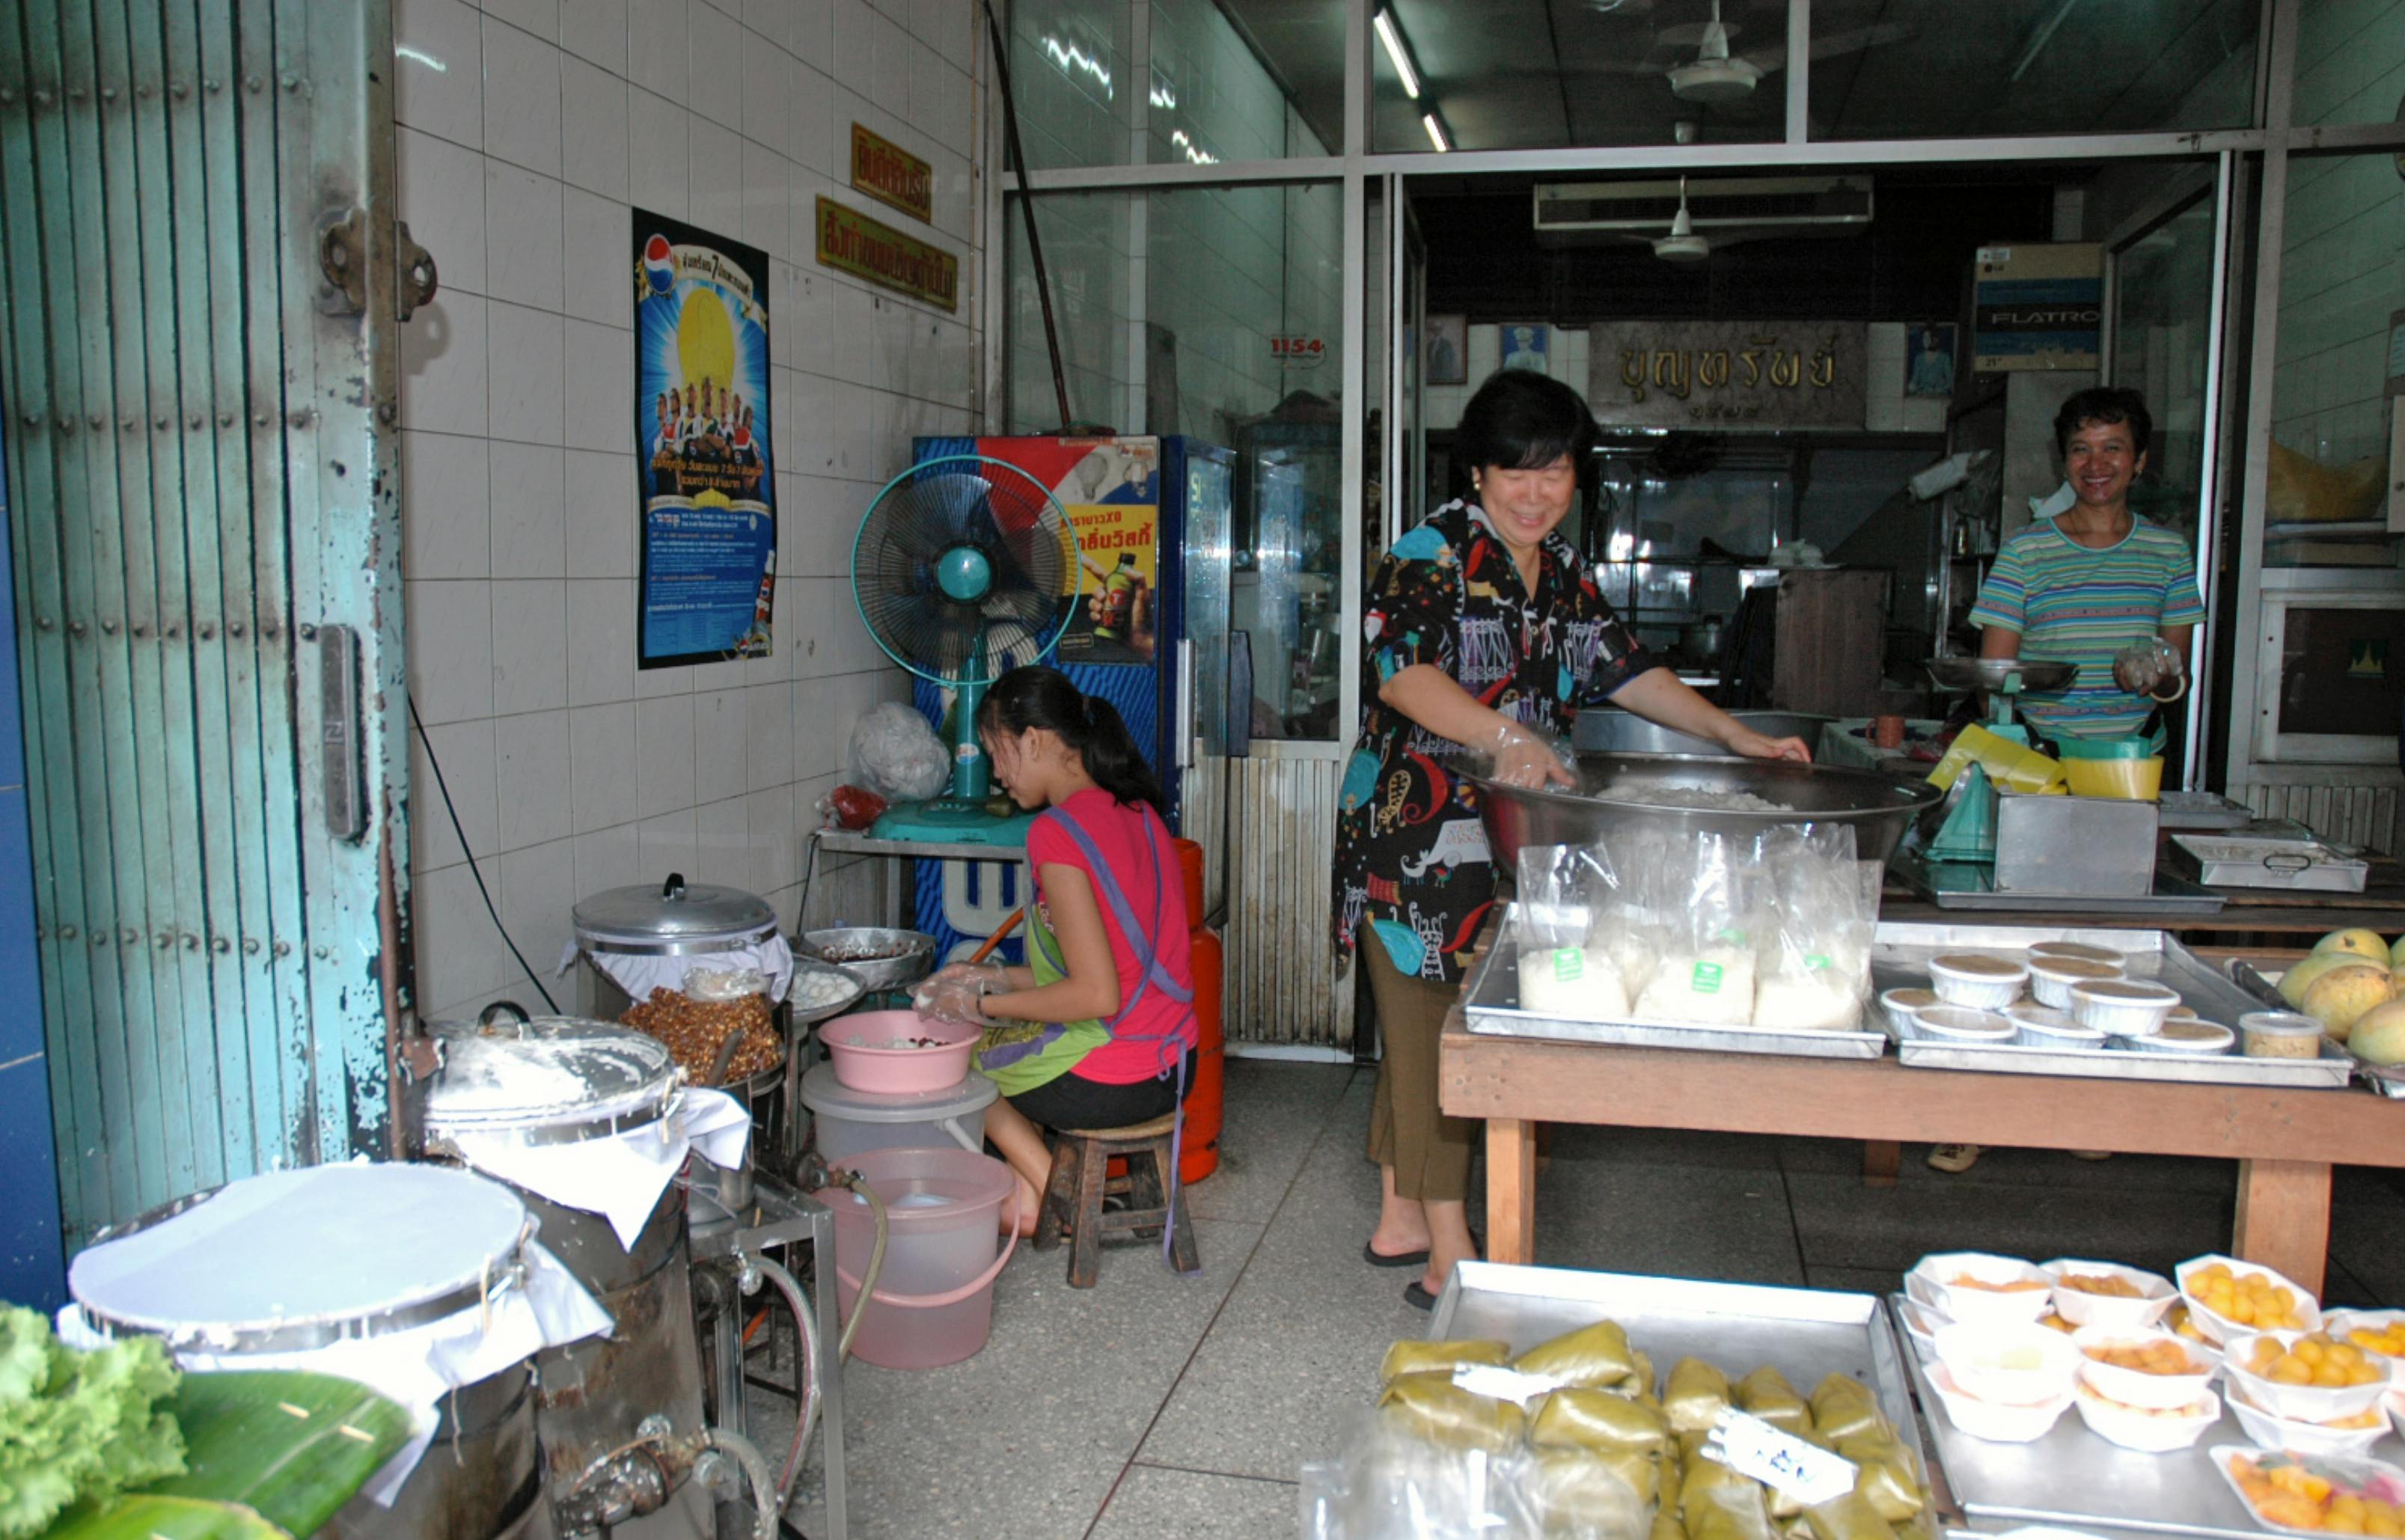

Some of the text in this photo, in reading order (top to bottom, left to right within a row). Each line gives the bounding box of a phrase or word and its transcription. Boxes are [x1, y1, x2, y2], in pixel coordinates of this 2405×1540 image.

[1991, 310, 2102, 325] FLATRO
[1271, 337, 1322, 353] 1154
[1620, 334, 1838, 402] บุญทรัพย์
